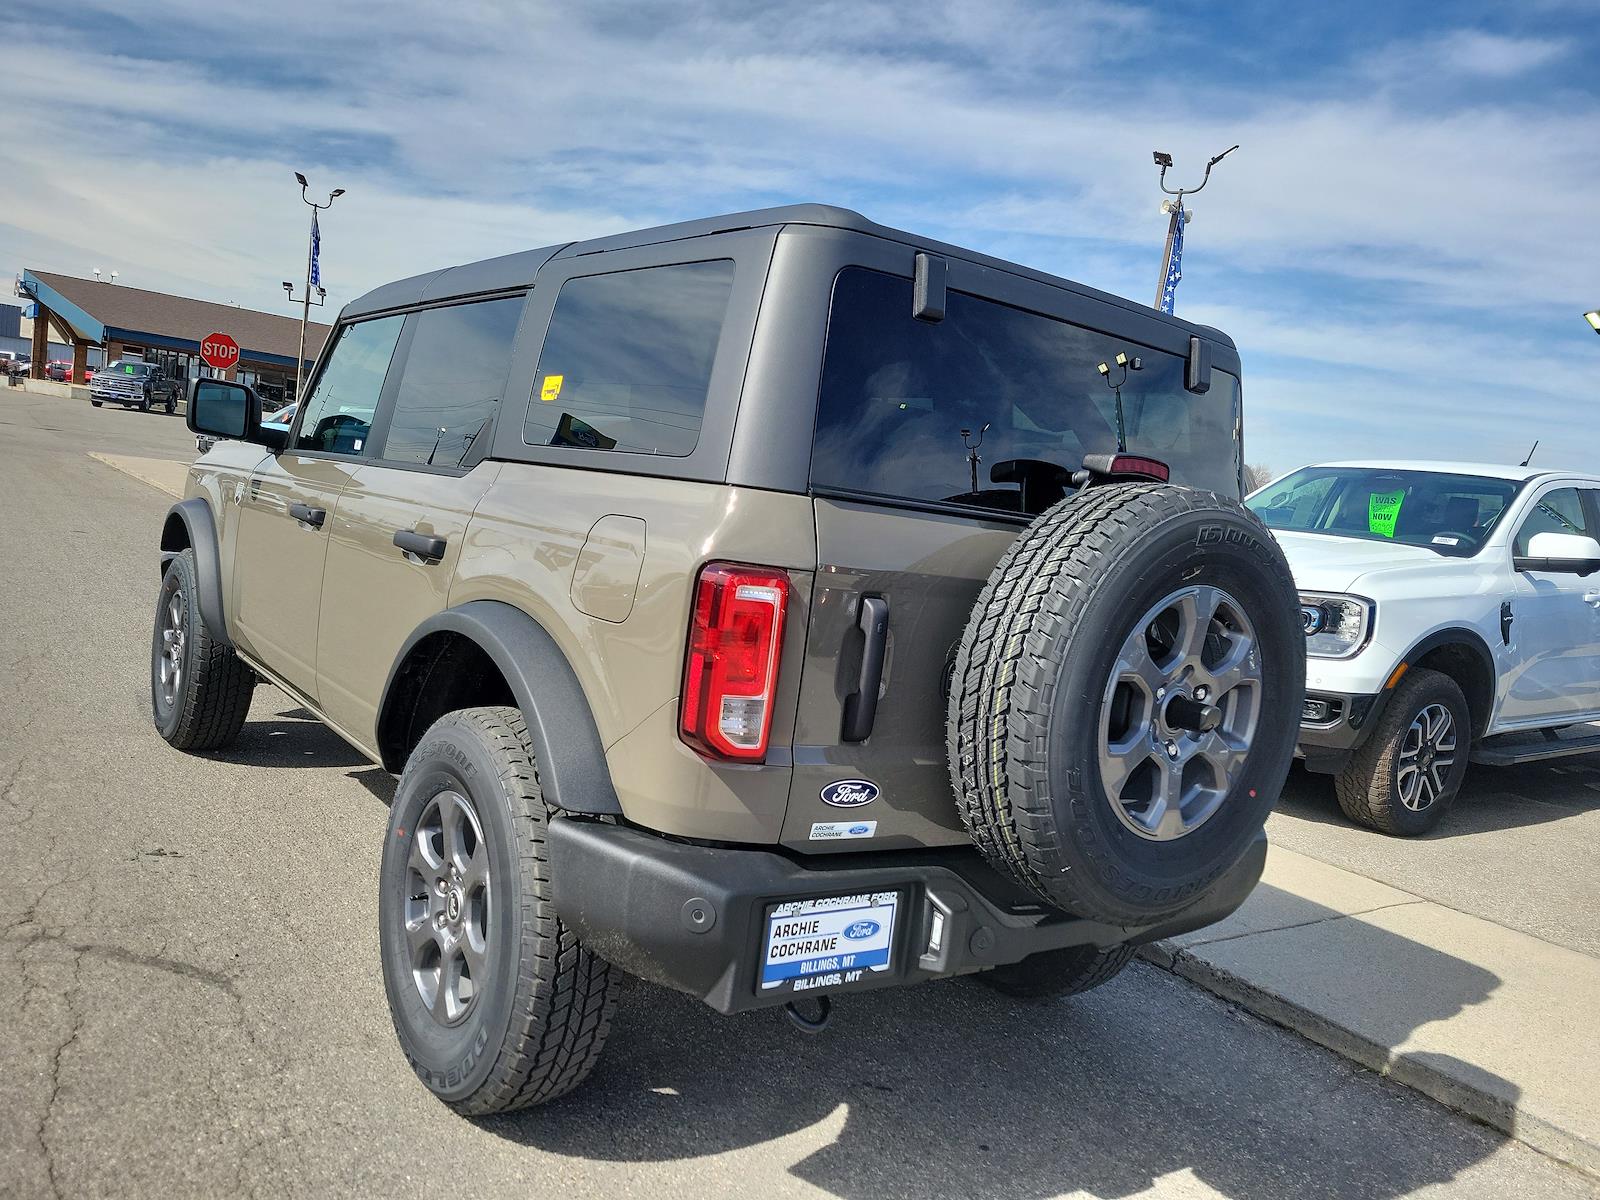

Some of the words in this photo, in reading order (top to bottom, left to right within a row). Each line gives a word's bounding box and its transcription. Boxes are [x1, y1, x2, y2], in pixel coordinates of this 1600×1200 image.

[203, 341, 238, 360] STOP
[1375, 496, 1397, 505] WAS
[1372, 512, 1393, 521] NOW
[832, 784, 870, 803] Ford
[775, 900, 814, 914] ARCHIE
[815, 894, 870, 908] COCHRANE
[870, 891, 898, 903] FORD
[773, 920, 820, 939] ARCHIE
[849, 920, 874, 938] Ford
[770, 937, 838, 959] COCHRANE
[800, 956, 840, 975] BILLINGS,
[842, 954, 856, 967] MT
[793, 972, 842, 992] BILLINGS,
[844, 969, 863, 983] MT
[405, 1024, 488, 1089] DUELE
